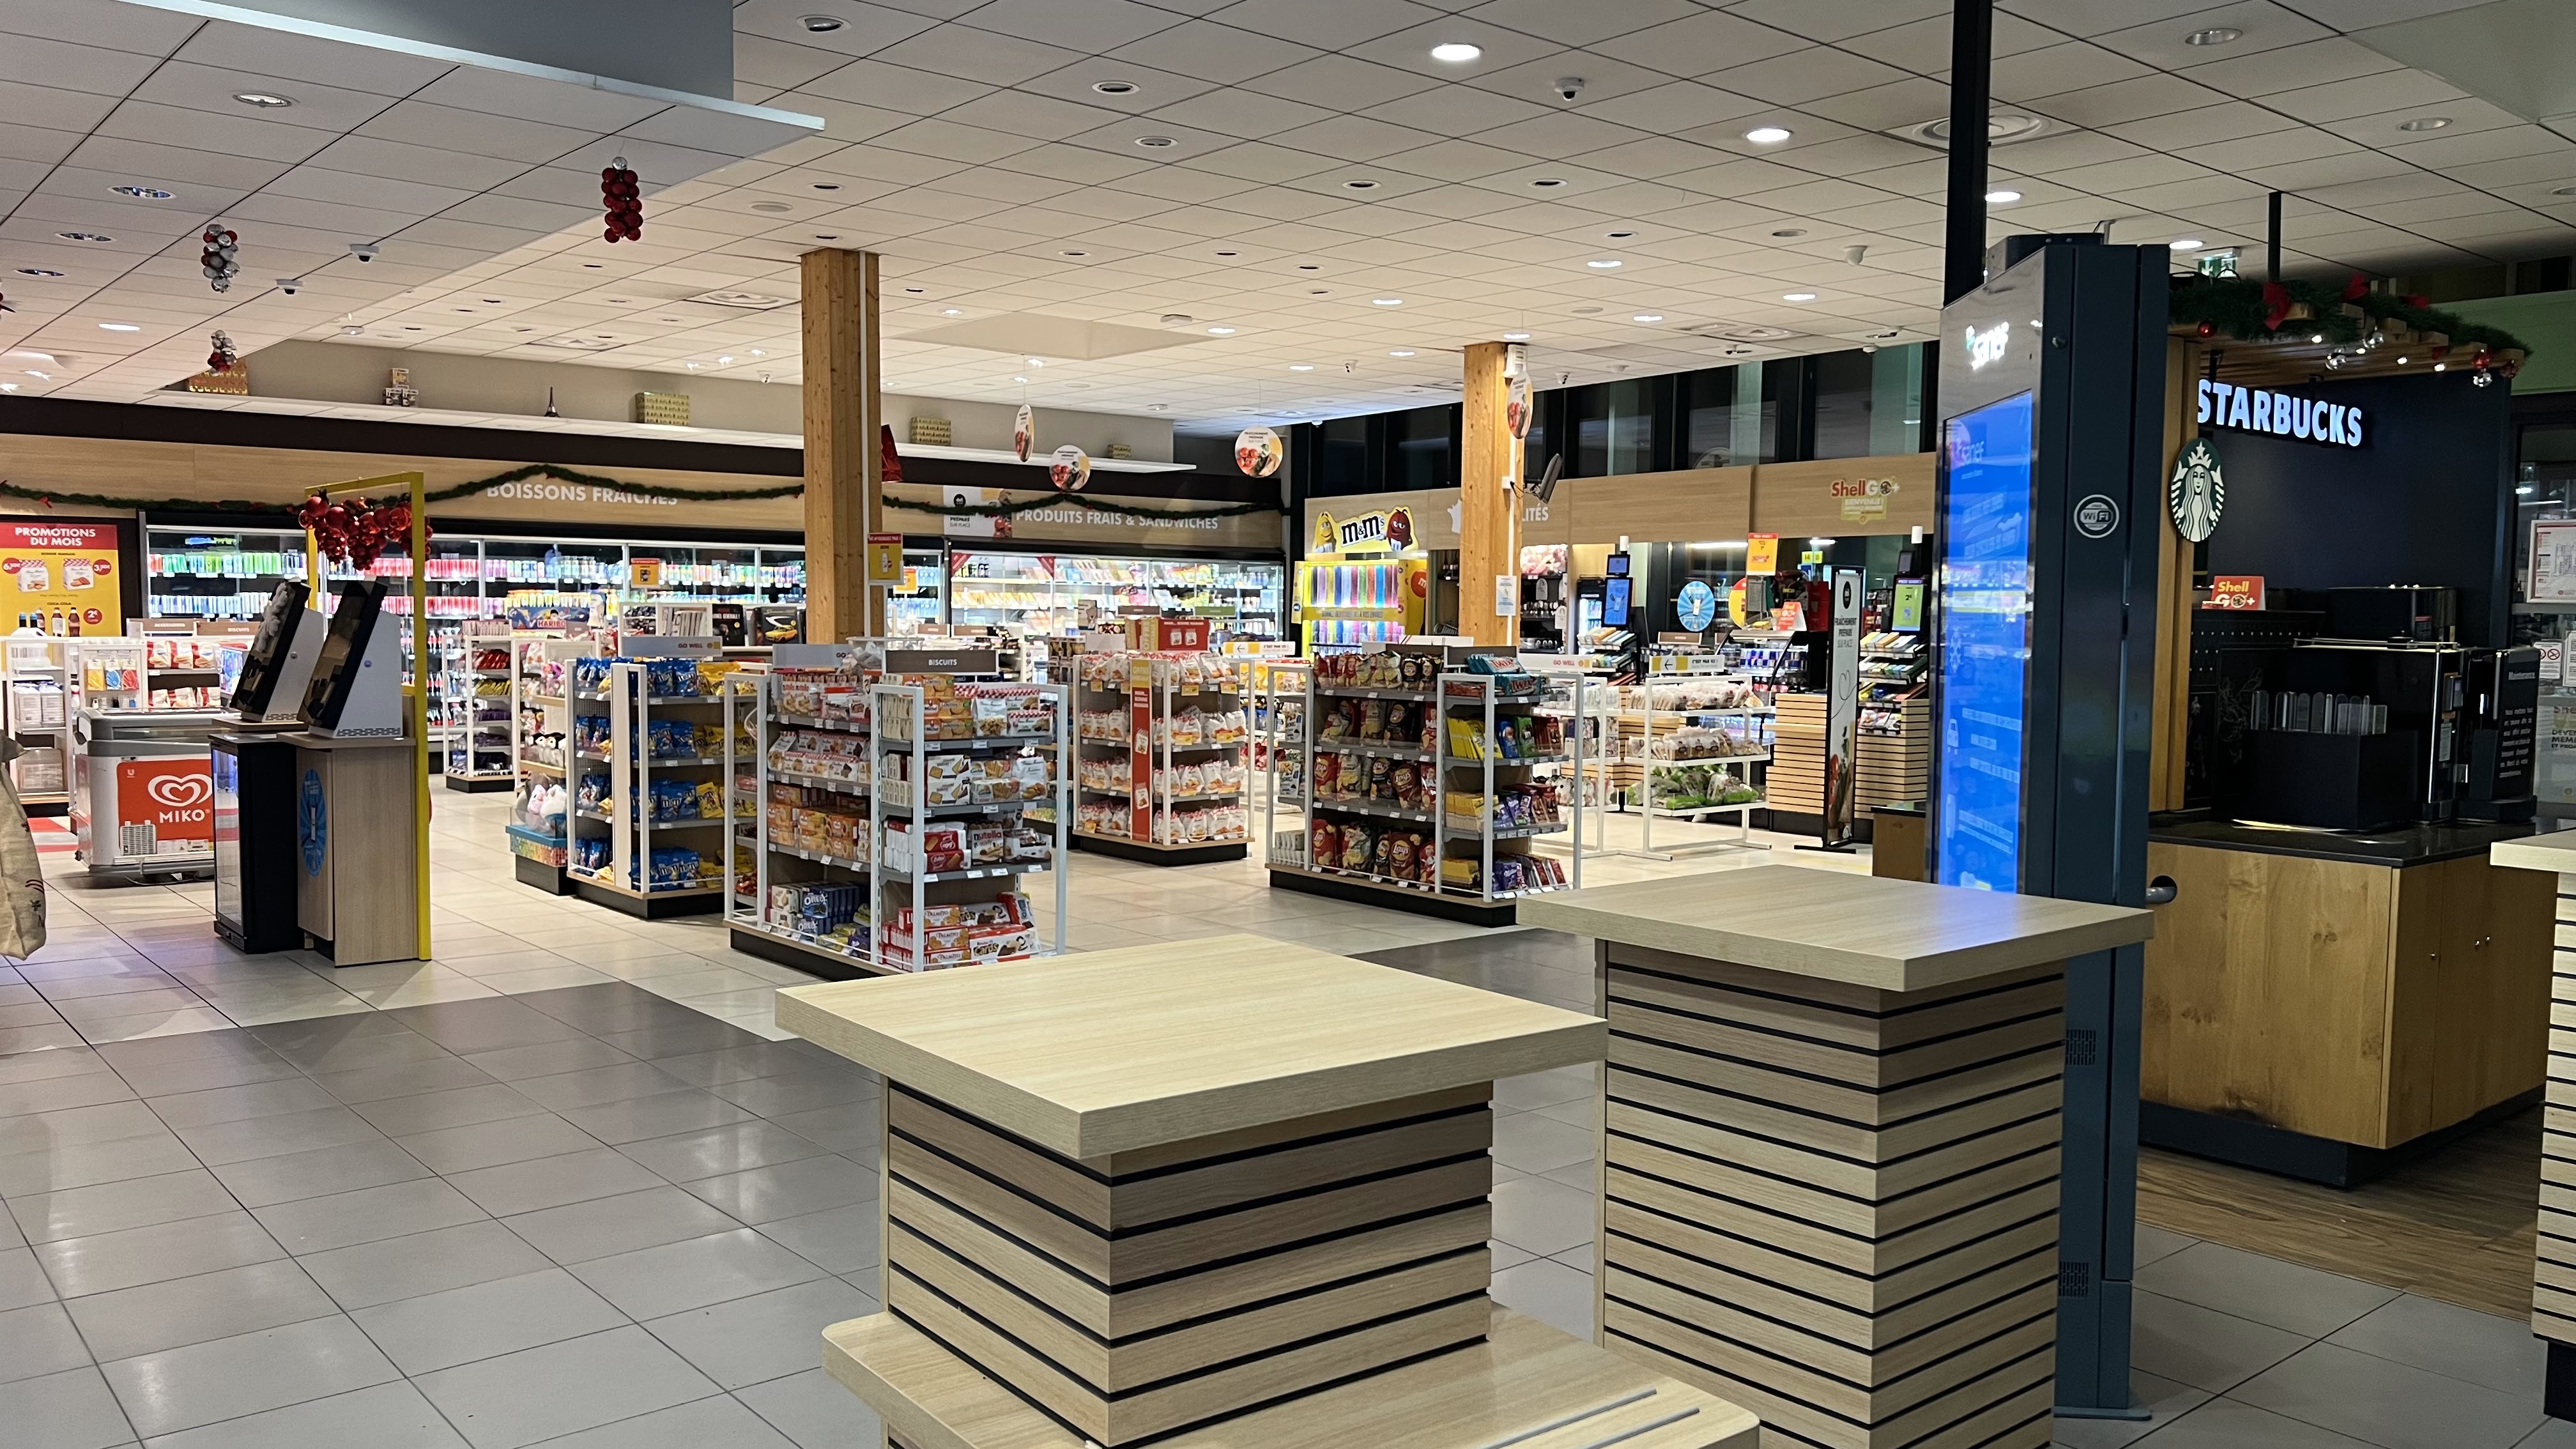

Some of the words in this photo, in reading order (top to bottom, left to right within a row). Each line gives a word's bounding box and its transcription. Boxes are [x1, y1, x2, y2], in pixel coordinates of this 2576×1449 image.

[2197, 378, 2363, 447] STARBUCKS
[487, 483, 586, 502] BOISSONS
[1016, 510, 1085, 524] PRODUITS
[1086, 512, 1122, 526] FRAIS
[1126, 515, 1135, 526] &
[1139, 515, 1218, 530] SANDWICHES
[15, 527, 96, 537] PROMOTIONS
[30, 537, 48, 546] DU
[50, 537, 82, 546] MOIS
[2218, 581, 2250, 592] Shell
[158, 809, 206, 824] MIKO
[973, 832, 1002, 840] nutella
